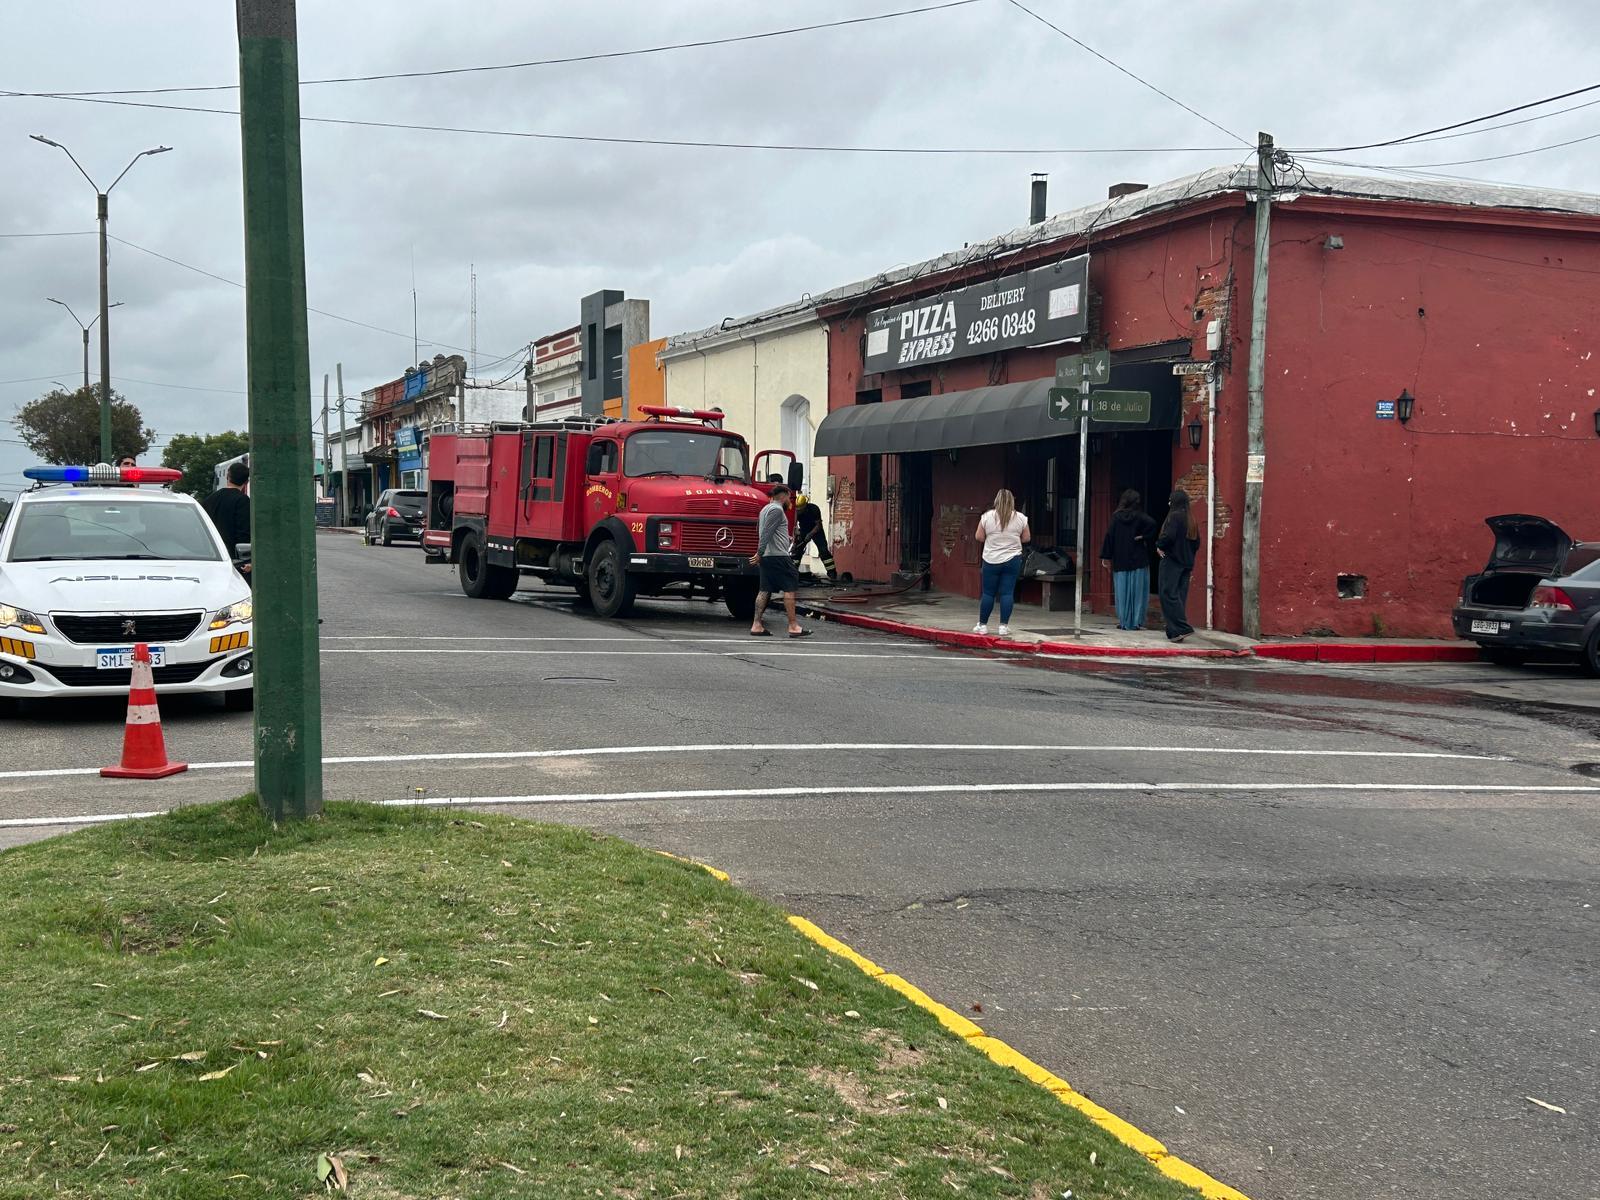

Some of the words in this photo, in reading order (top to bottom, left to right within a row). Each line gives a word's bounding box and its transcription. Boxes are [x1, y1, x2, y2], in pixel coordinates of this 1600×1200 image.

[980, 287, 1025, 311] DELIVERY
[900, 300, 957, 340] PIZZA
[966, 317, 998, 345] 4266
[1002, 309, 1036, 338] 0348
[898, 331, 957, 364] EXPRESS
[1099, 401, 1108, 411] 18
[1111, 401, 1121, 411] de
[1124, 402, 1143, 412] Julio
[586, 485, 613, 499] BOMBEROS
[685, 489, 758, 499] BOMBEROS
[631, 522, 643, 533] 212
